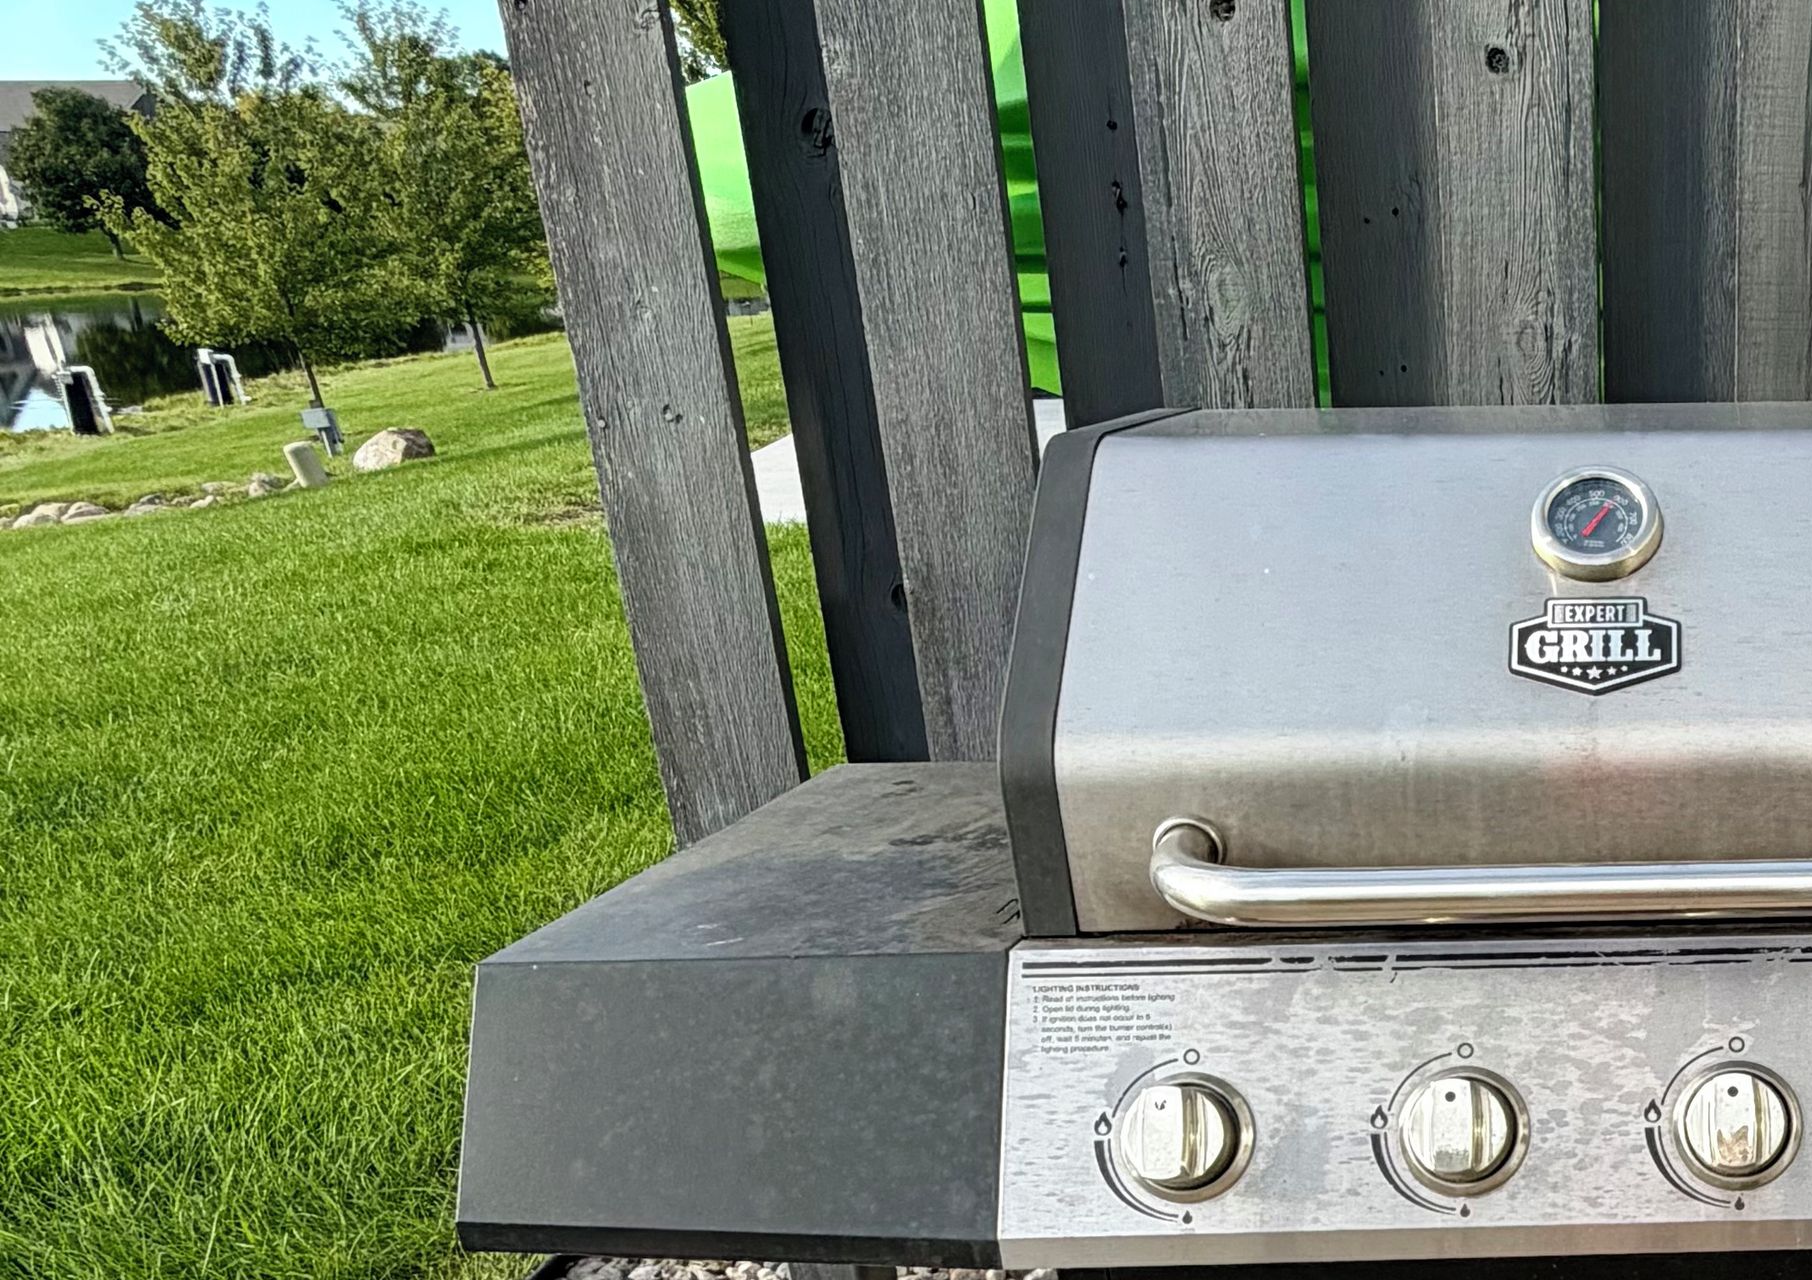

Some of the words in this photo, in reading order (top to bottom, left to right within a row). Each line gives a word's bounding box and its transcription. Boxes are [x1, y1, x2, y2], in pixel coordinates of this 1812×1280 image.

[1564, 605, 1625, 623] EXPERT
[1524, 629, 1662, 664] GRILL
[1032, 984, 1074, 993] LIGHTING
[1076, 983, 1140, 993] INSTRUCTIONS
[1042, 1005, 1064, 1014] Open
